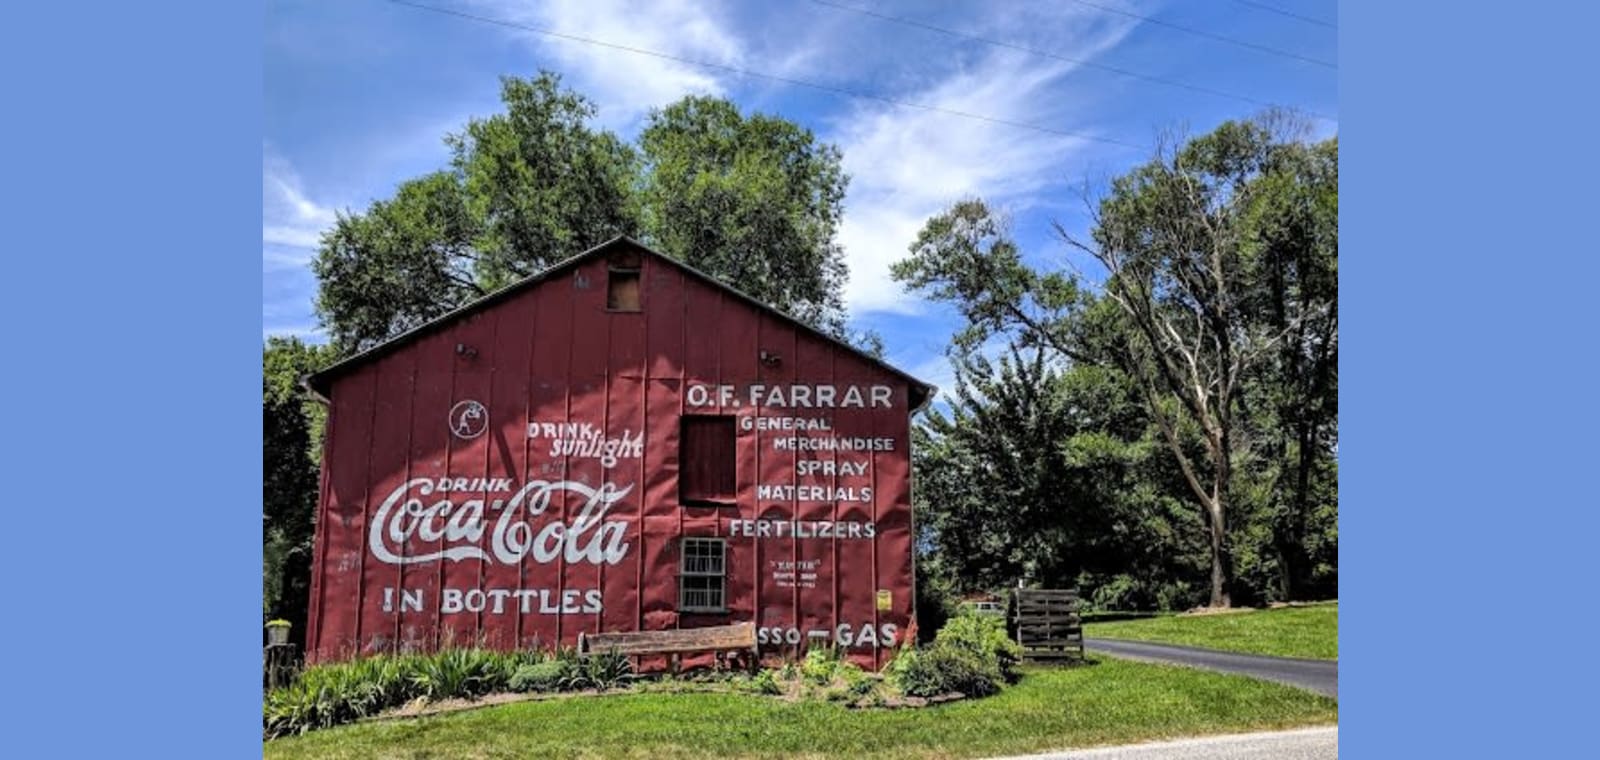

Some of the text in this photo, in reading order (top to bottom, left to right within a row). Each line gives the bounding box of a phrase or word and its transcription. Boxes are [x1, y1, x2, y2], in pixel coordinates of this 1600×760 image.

[750, 384, 892, 409] FARRAR
[528, 422, 593, 439] DRINK
[741, 416, 831, 431] GENERAL
[549, 429, 644, 468] sunlight
[773, 438, 895, 451] MERCHANDISE
[797, 460, 868, 476] SPRAY
[436, 478, 514, 492] DRINK
[758, 485, 872, 502] MATERIALS
[730, 519, 876, 538] FERTILIZERS
[383, 587, 604, 614] IN BOTTLES
[758, 626, 800, 645] SSO
